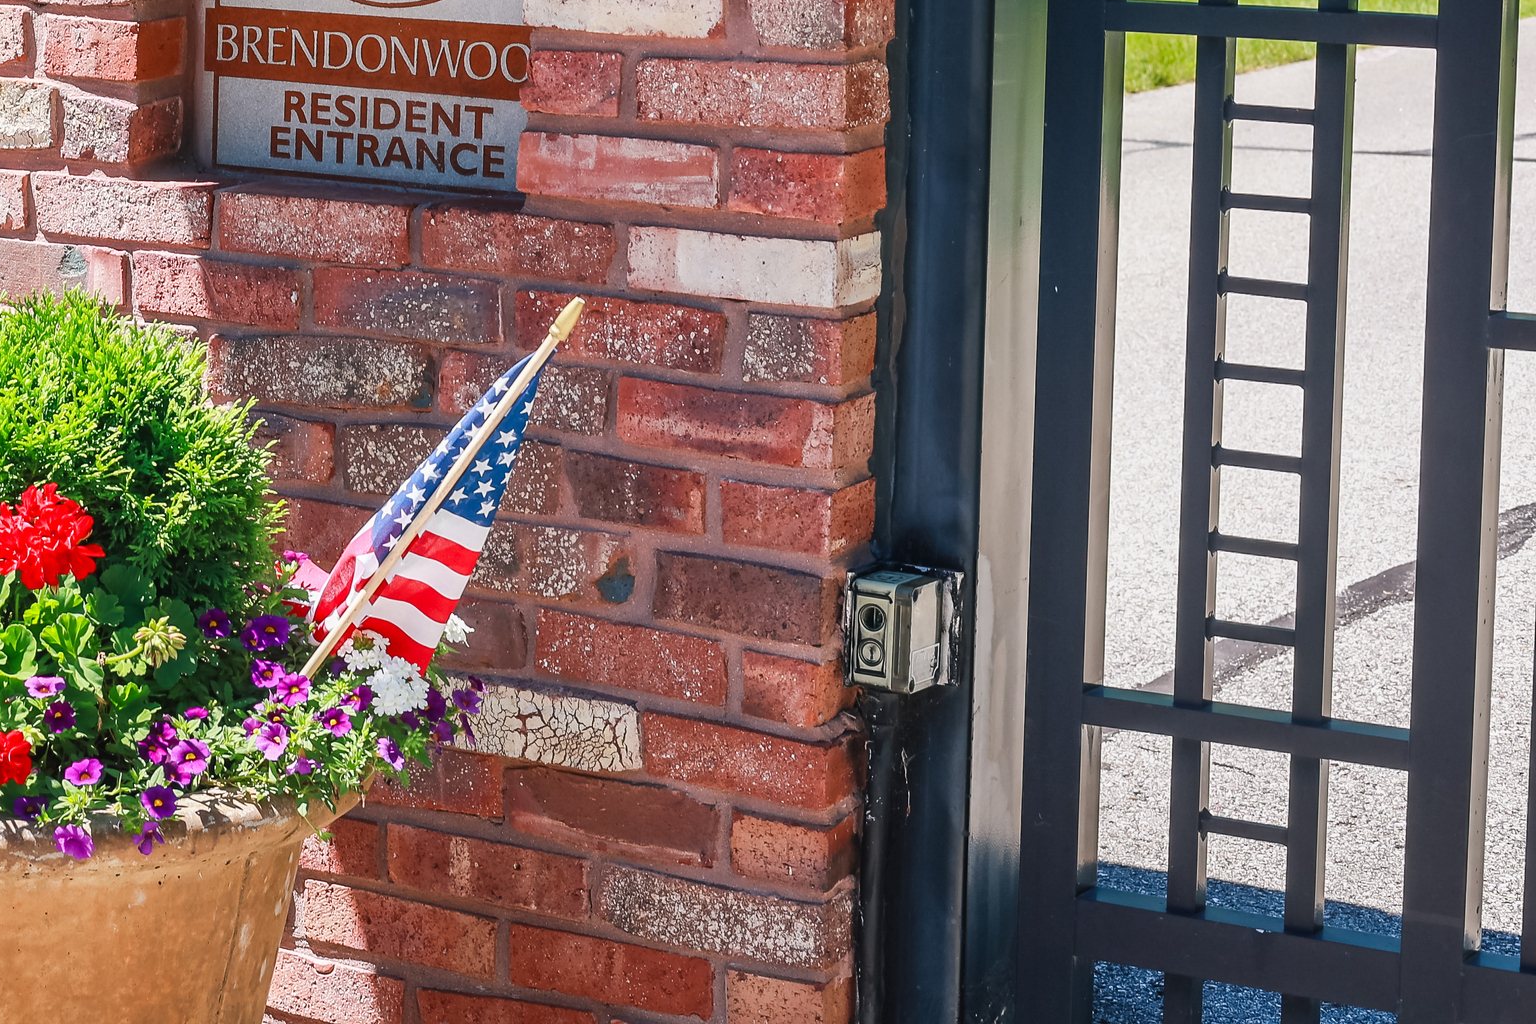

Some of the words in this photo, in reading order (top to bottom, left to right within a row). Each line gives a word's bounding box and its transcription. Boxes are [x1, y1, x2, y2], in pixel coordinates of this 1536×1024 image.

[216, 23, 531, 84] BRENDONWOO
[283, 89, 494, 140] RESIDENT
[269, 126, 506, 179] ENTRANCE
